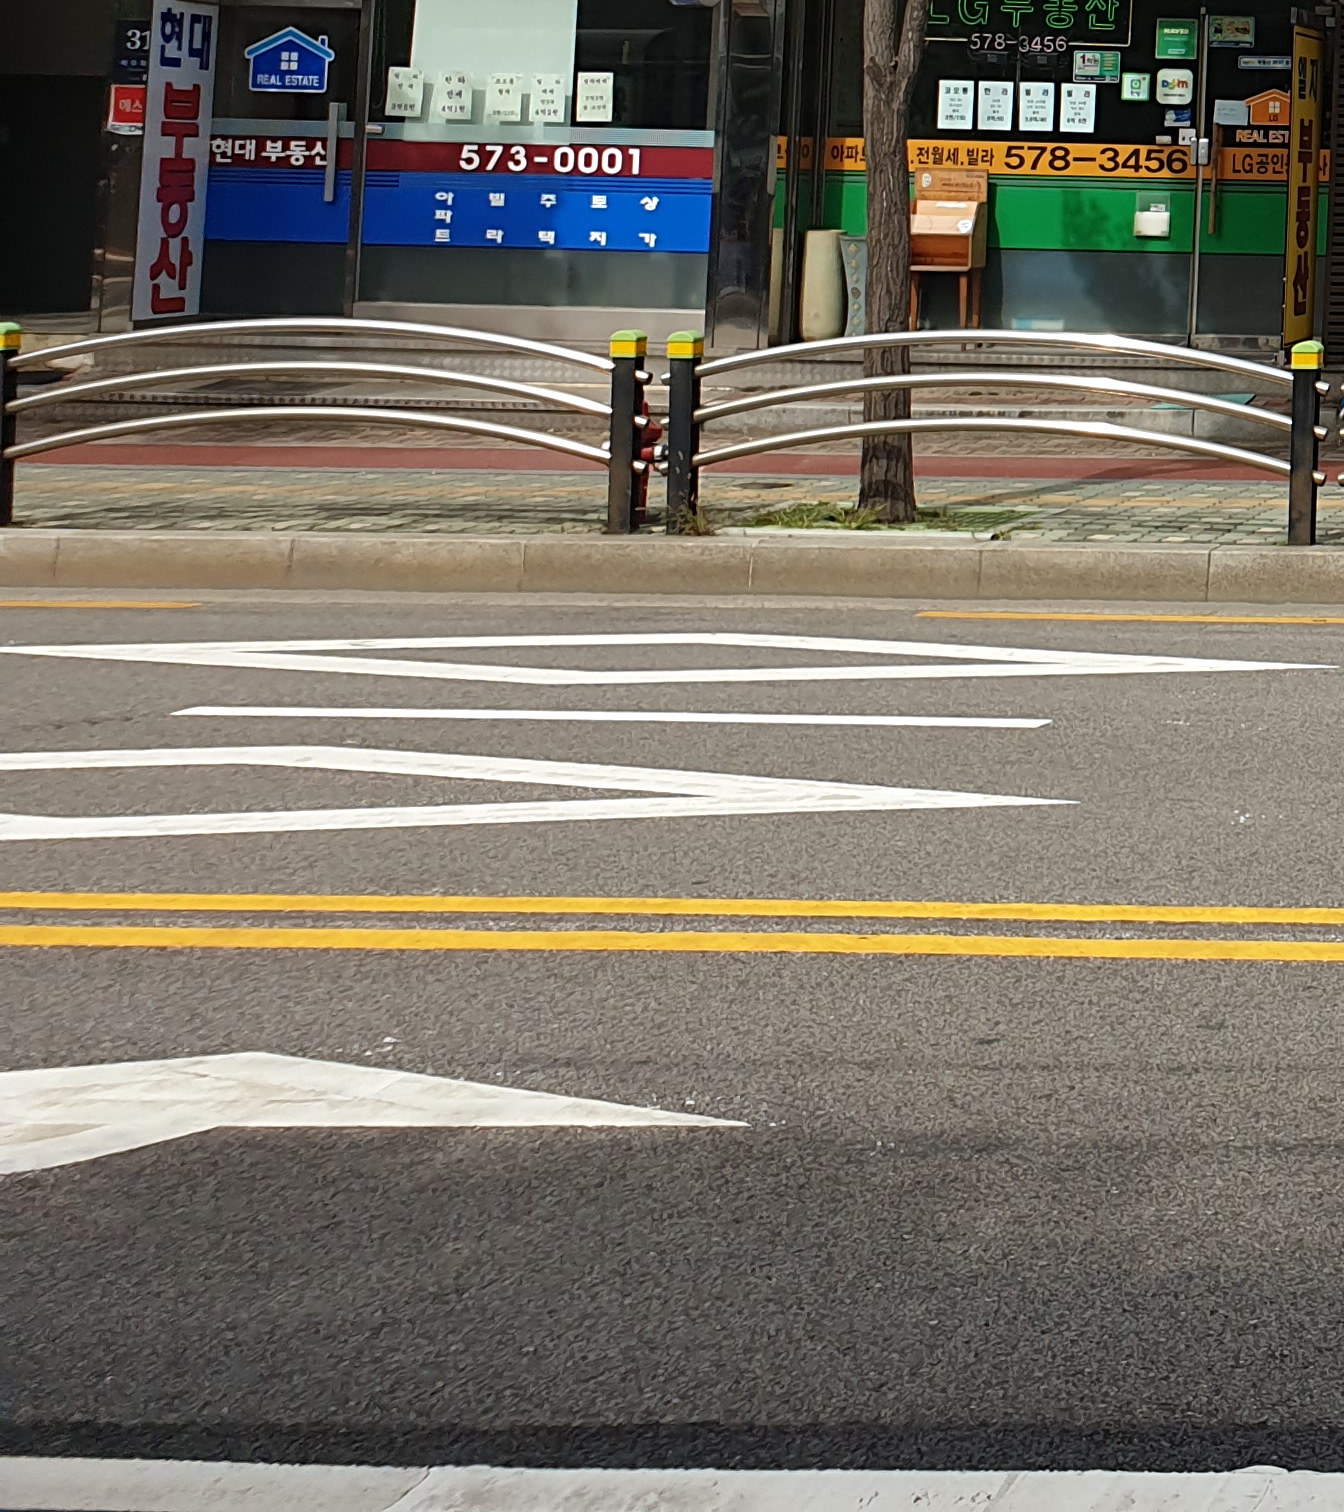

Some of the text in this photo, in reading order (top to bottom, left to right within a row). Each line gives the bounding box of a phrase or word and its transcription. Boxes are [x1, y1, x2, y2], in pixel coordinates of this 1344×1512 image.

[969, 33, 1067, 53] 578-3456
[256, 74, 320, 88] REAL ESTATE
[211, 138, 329, 166] 현대 부동산
[1236, 130, 1290, 144] REAL EST
[149, 7, 214, 315] 현대 부동산
[459, 144, 641, 175] 573-0001
[1004, 145, 1189, 175] 578-3456
[589, 194, 608, 247] 토지
[638, 195, 659, 248] 상가
[1292, 117, 1314, 318] 부동산
